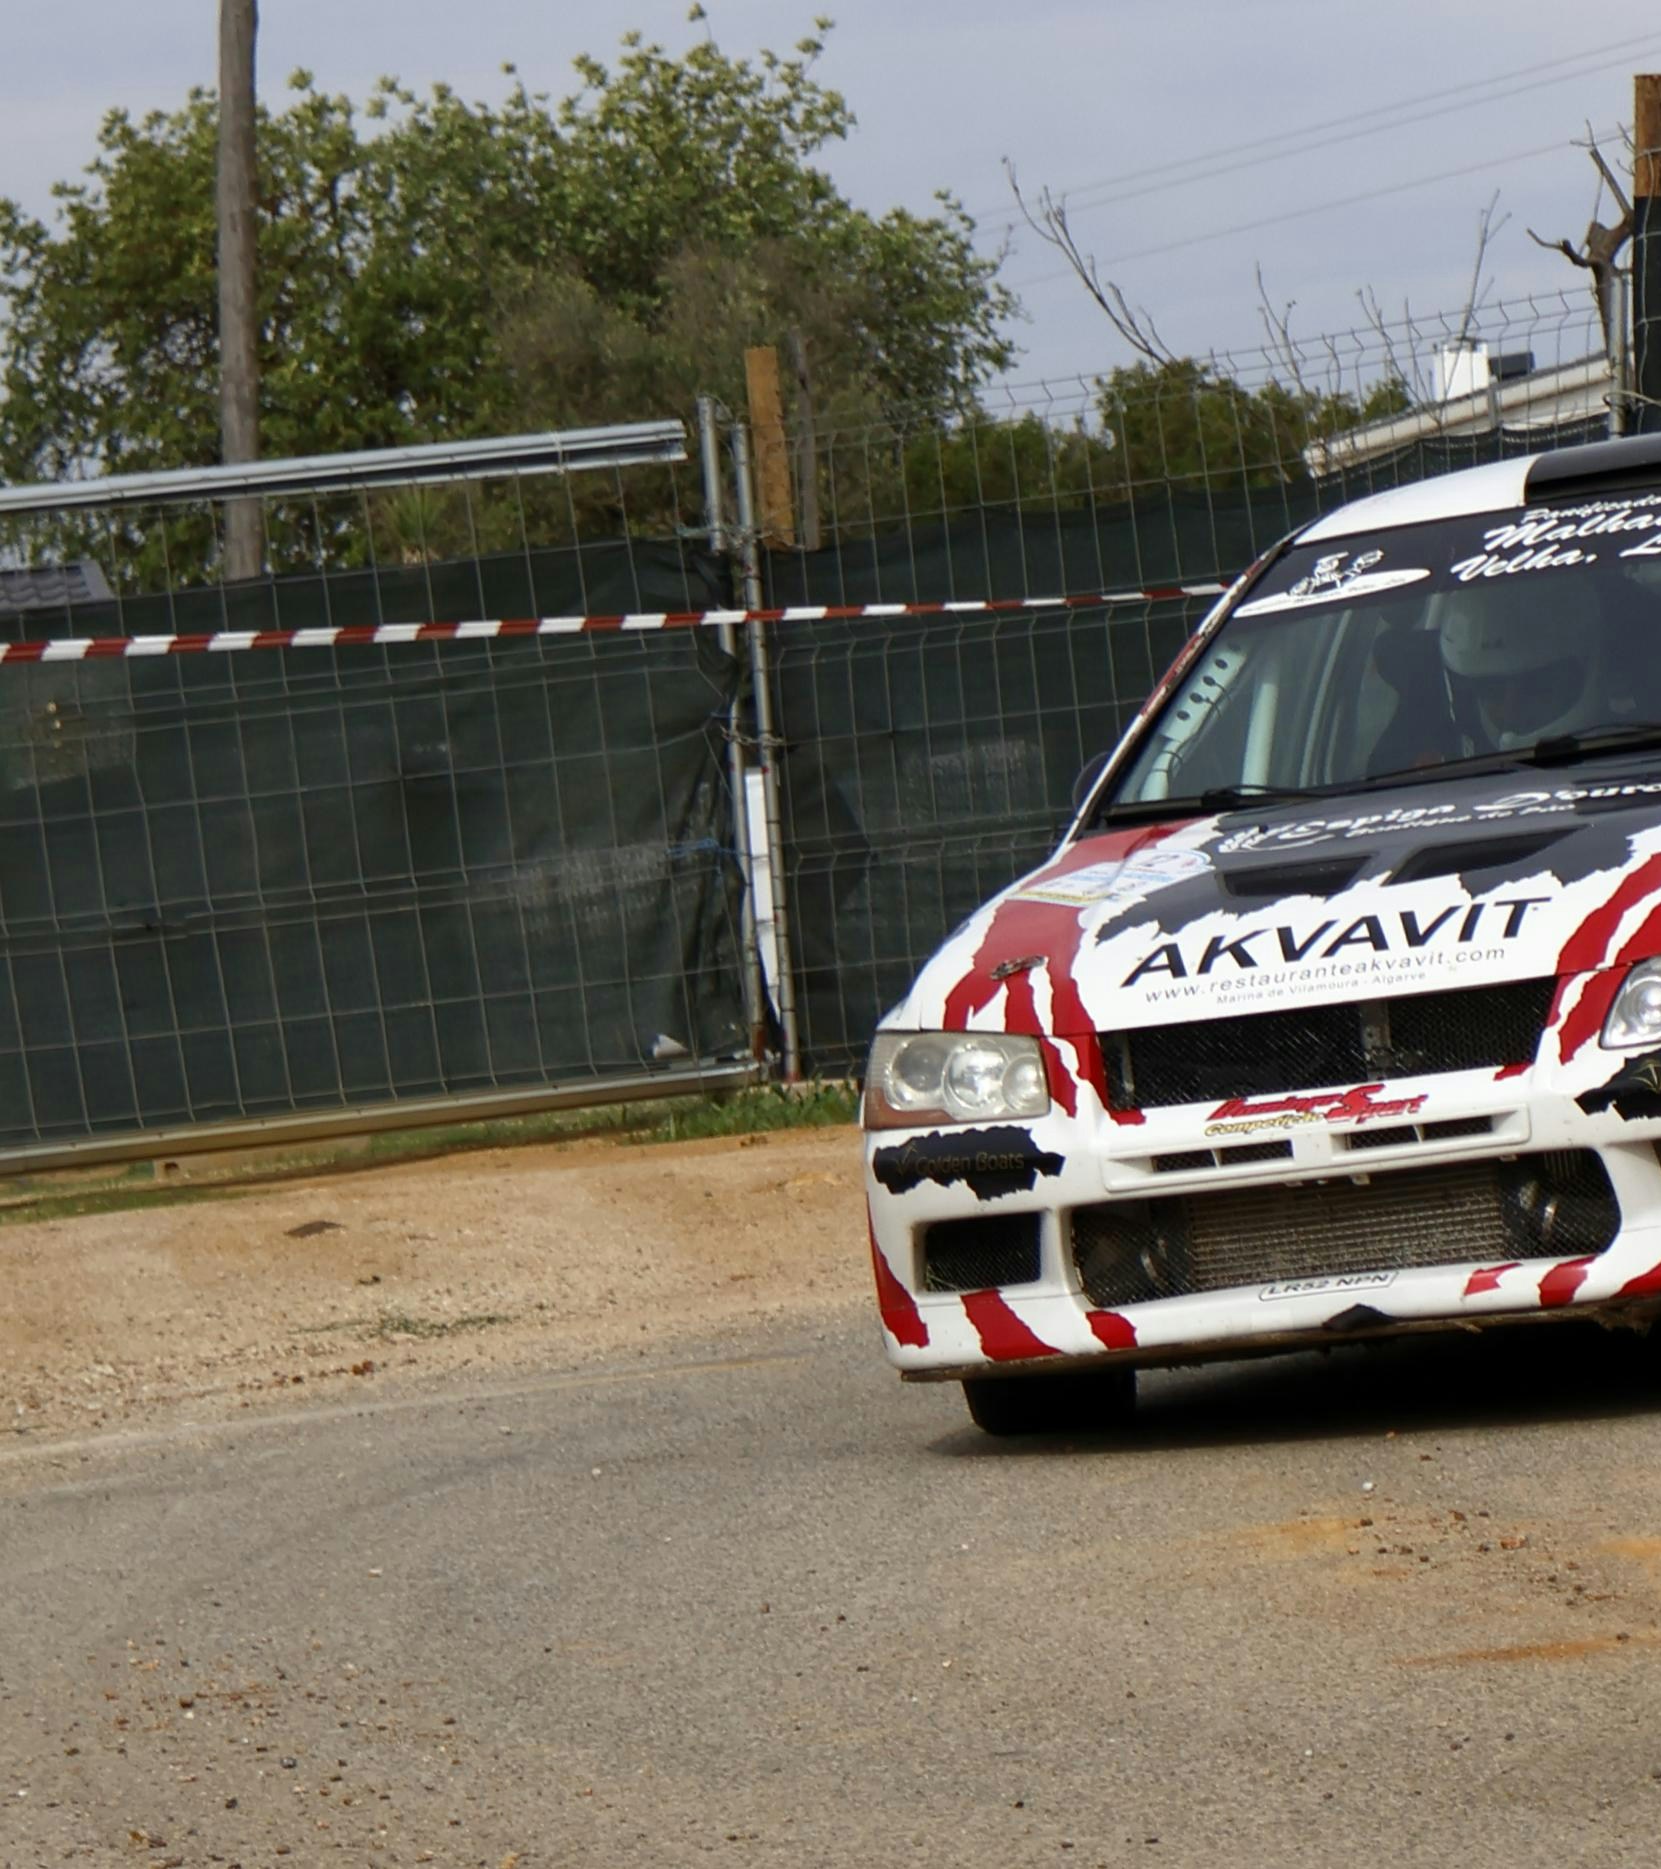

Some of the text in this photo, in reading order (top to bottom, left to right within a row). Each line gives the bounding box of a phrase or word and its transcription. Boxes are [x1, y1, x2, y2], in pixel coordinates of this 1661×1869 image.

[1450, 544, 1598, 582] Velha,
[1119, 896, 1553, 988] AKVAVIT
[1144, 946, 1506, 1004] www.restauranteakvavit.com
[1216, 990, 1265, 1005] Marina
[1267, 986, 1284, 997] de
[1288, 977, 1360, 995] Vilamoura
[1372, 970, 1426, 988] Algarve
[914, 1150, 1025, 1176] Golden Boats
